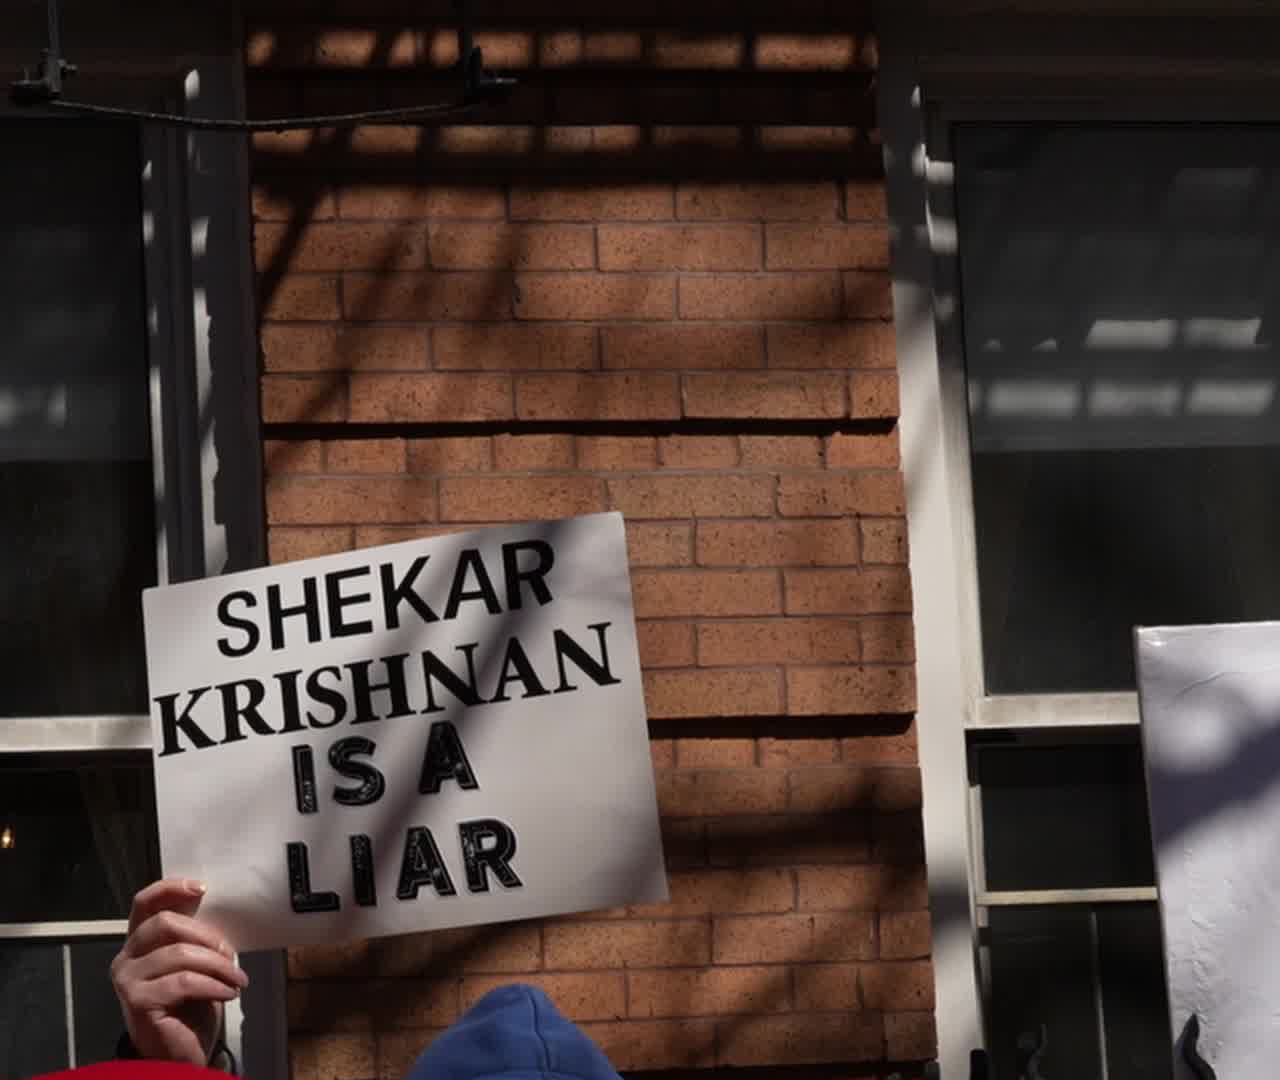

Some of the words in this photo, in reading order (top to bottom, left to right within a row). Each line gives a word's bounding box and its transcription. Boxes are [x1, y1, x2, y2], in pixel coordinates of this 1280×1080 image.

[217, 539, 556, 659] SHEKAR
[153, 622, 622, 758] KRISHNAN
[291, 735, 386, 815] IS
[418, 720, 480, 795] A
[286, 818, 524, 914] LIAR
